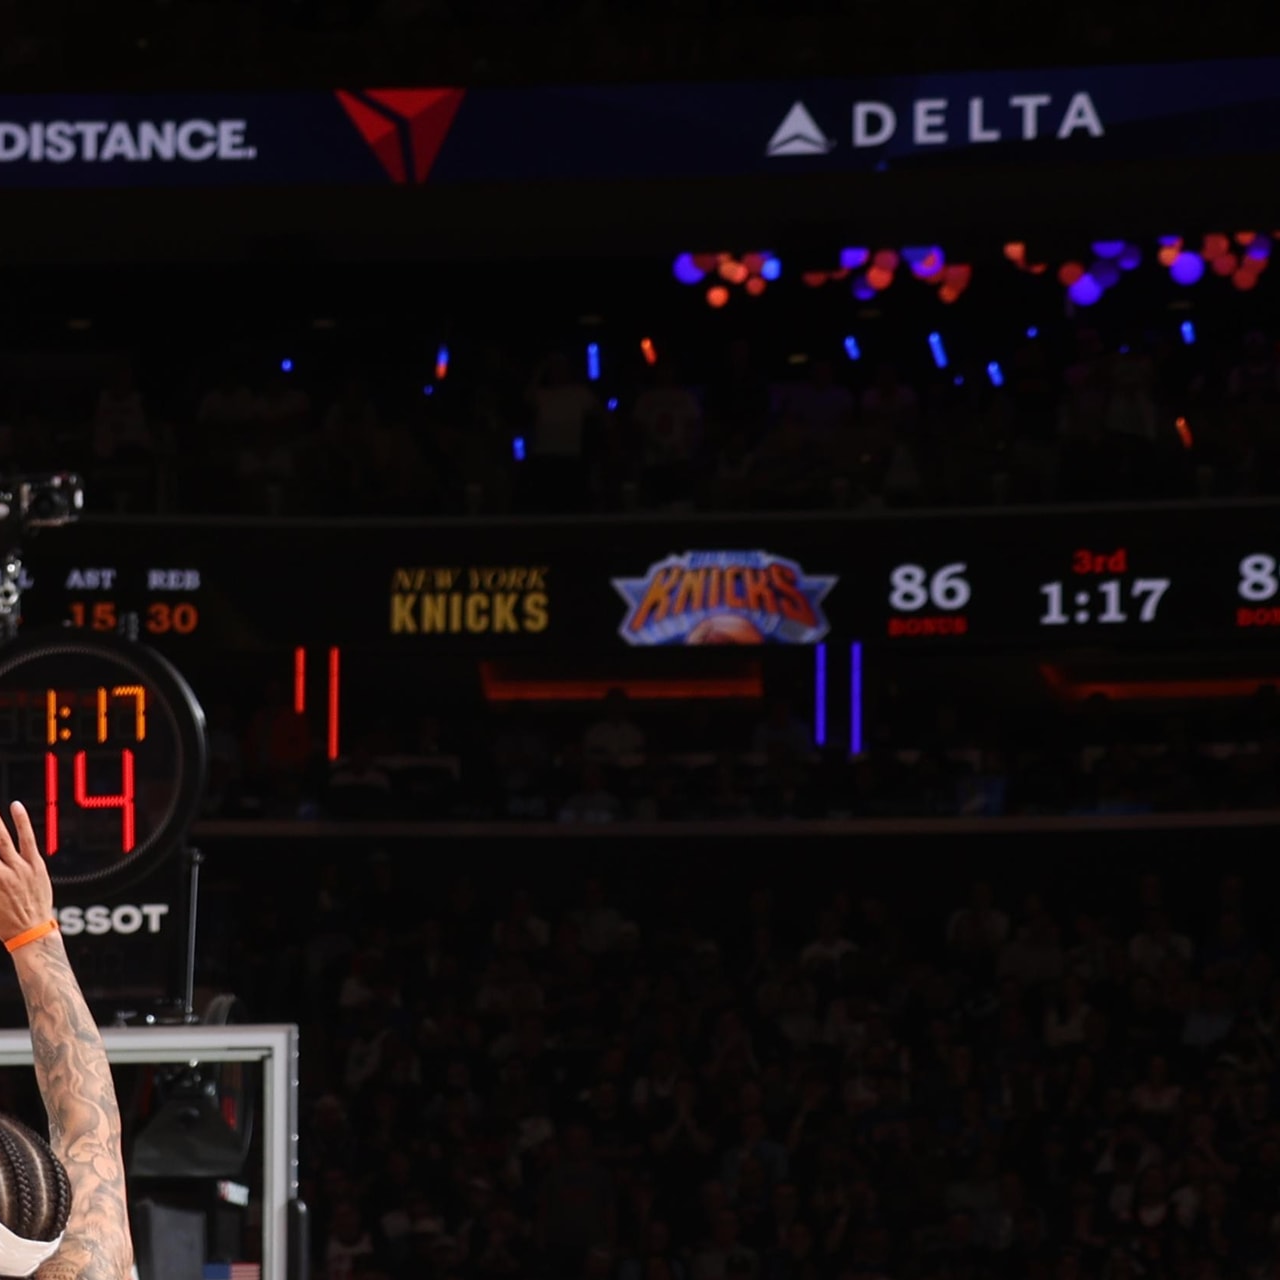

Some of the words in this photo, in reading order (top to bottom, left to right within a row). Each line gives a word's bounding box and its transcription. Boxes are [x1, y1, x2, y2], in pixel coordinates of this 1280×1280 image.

[853, 92, 1105, 149] DELTA
[66, 569, 118, 591] AST
[147, 569, 203, 593] REB
[393, 567, 461, 592] NEW
[468, 566, 550, 592] YORK
[1073, 548, 1130, 576] 3rd
[1238, 554, 1280, 602] 8
[630, 563, 817, 632] KNICKS
[889, 563, 972, 612] 86
[1041, 578, 1172, 627] 1:17
[69, 602, 119, 633] 15
[146, 602, 201, 636] 30
[391, 593, 551, 634] KNICKS
[887, 616, 970, 638] BONUS
[46, 685, 147, 745] 1:17
[44, 748, 137, 857] 14
[51, 902, 171, 936] SSOT
